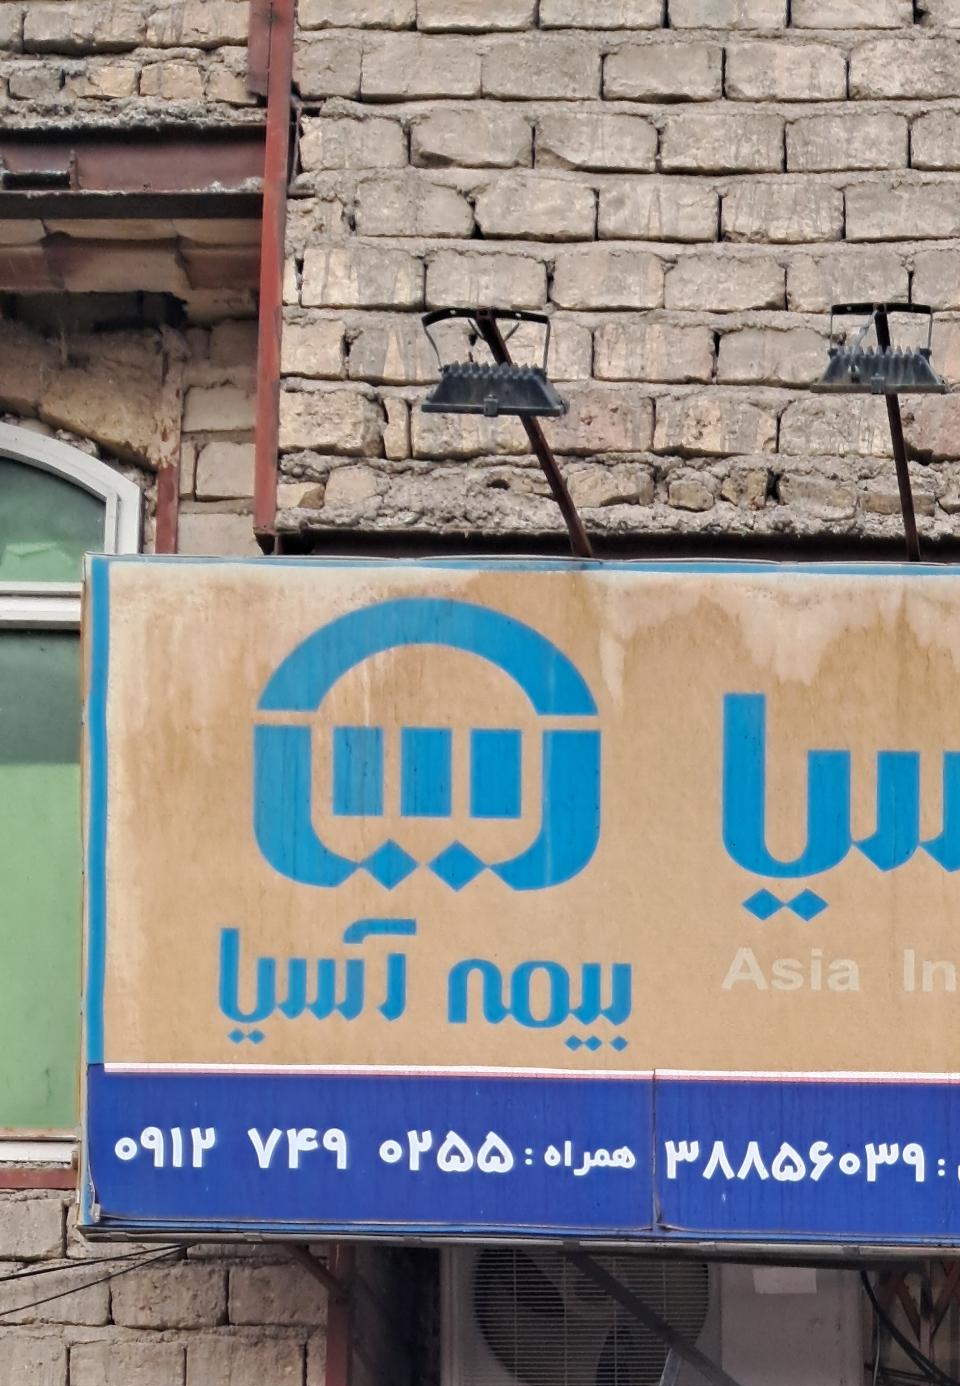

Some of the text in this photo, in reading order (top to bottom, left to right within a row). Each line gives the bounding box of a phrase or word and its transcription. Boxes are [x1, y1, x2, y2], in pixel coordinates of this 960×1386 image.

[219, 919, 632, 1051] بیمه آسیا
[721, 947, 860, 991] Asia
[114, 1126, 216, 1168] ۰۹۱۲
[247, 1127, 347, 1170] ۷۴۹
[379, 1128, 514, 1173] ۰۲۵۵
[664, 1139, 925, 1182] ۳۸۸۵۶۰۳۹
